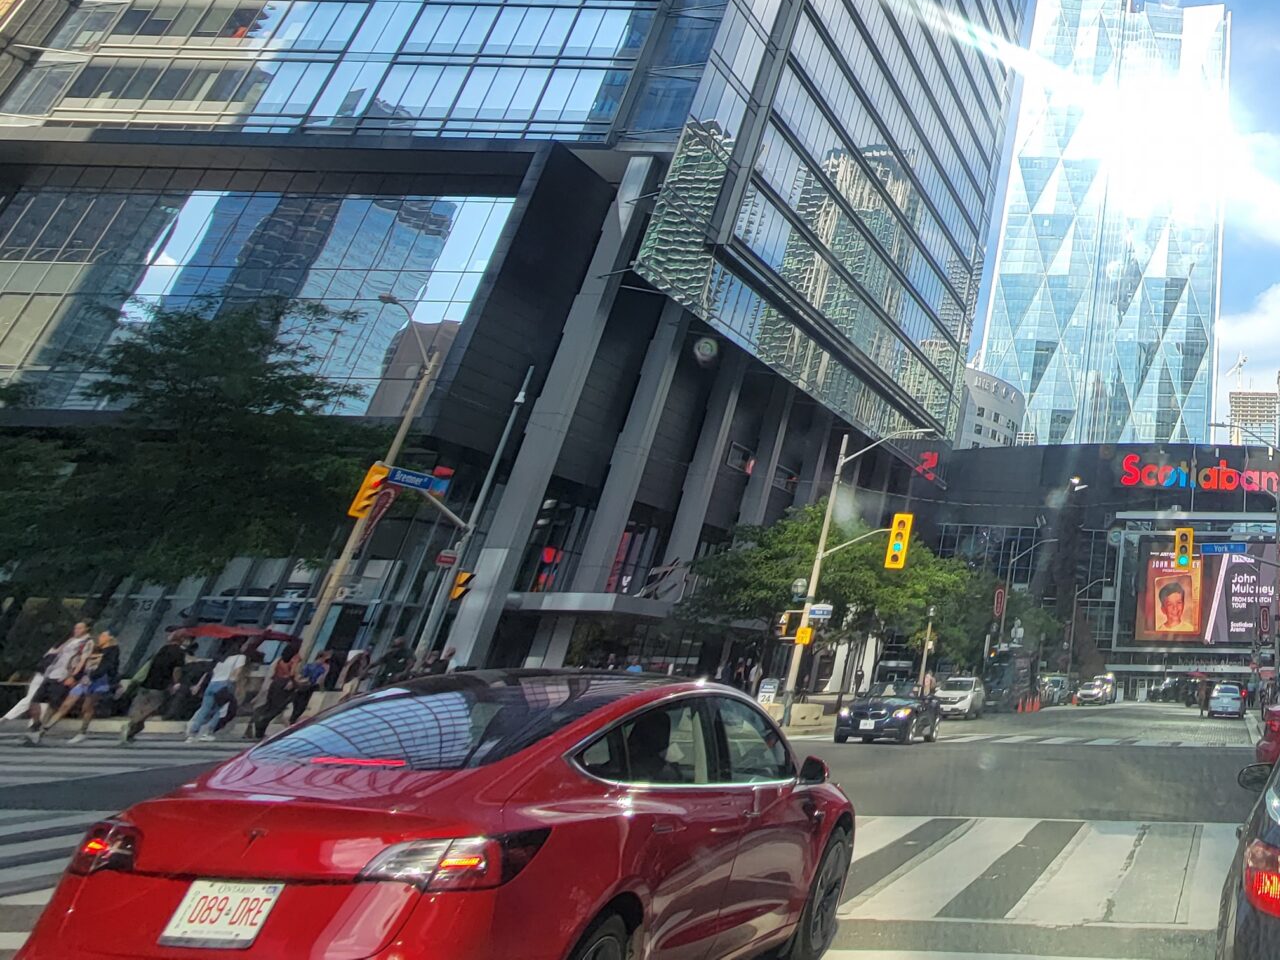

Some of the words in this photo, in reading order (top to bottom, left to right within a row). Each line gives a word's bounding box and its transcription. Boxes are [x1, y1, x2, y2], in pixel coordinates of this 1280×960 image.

[1214, 543, 1228, 553] York
[1231, 573, 1256, 583] John
[187, 895, 230, 925] 089
[228, 897, 273, 927] DRE
